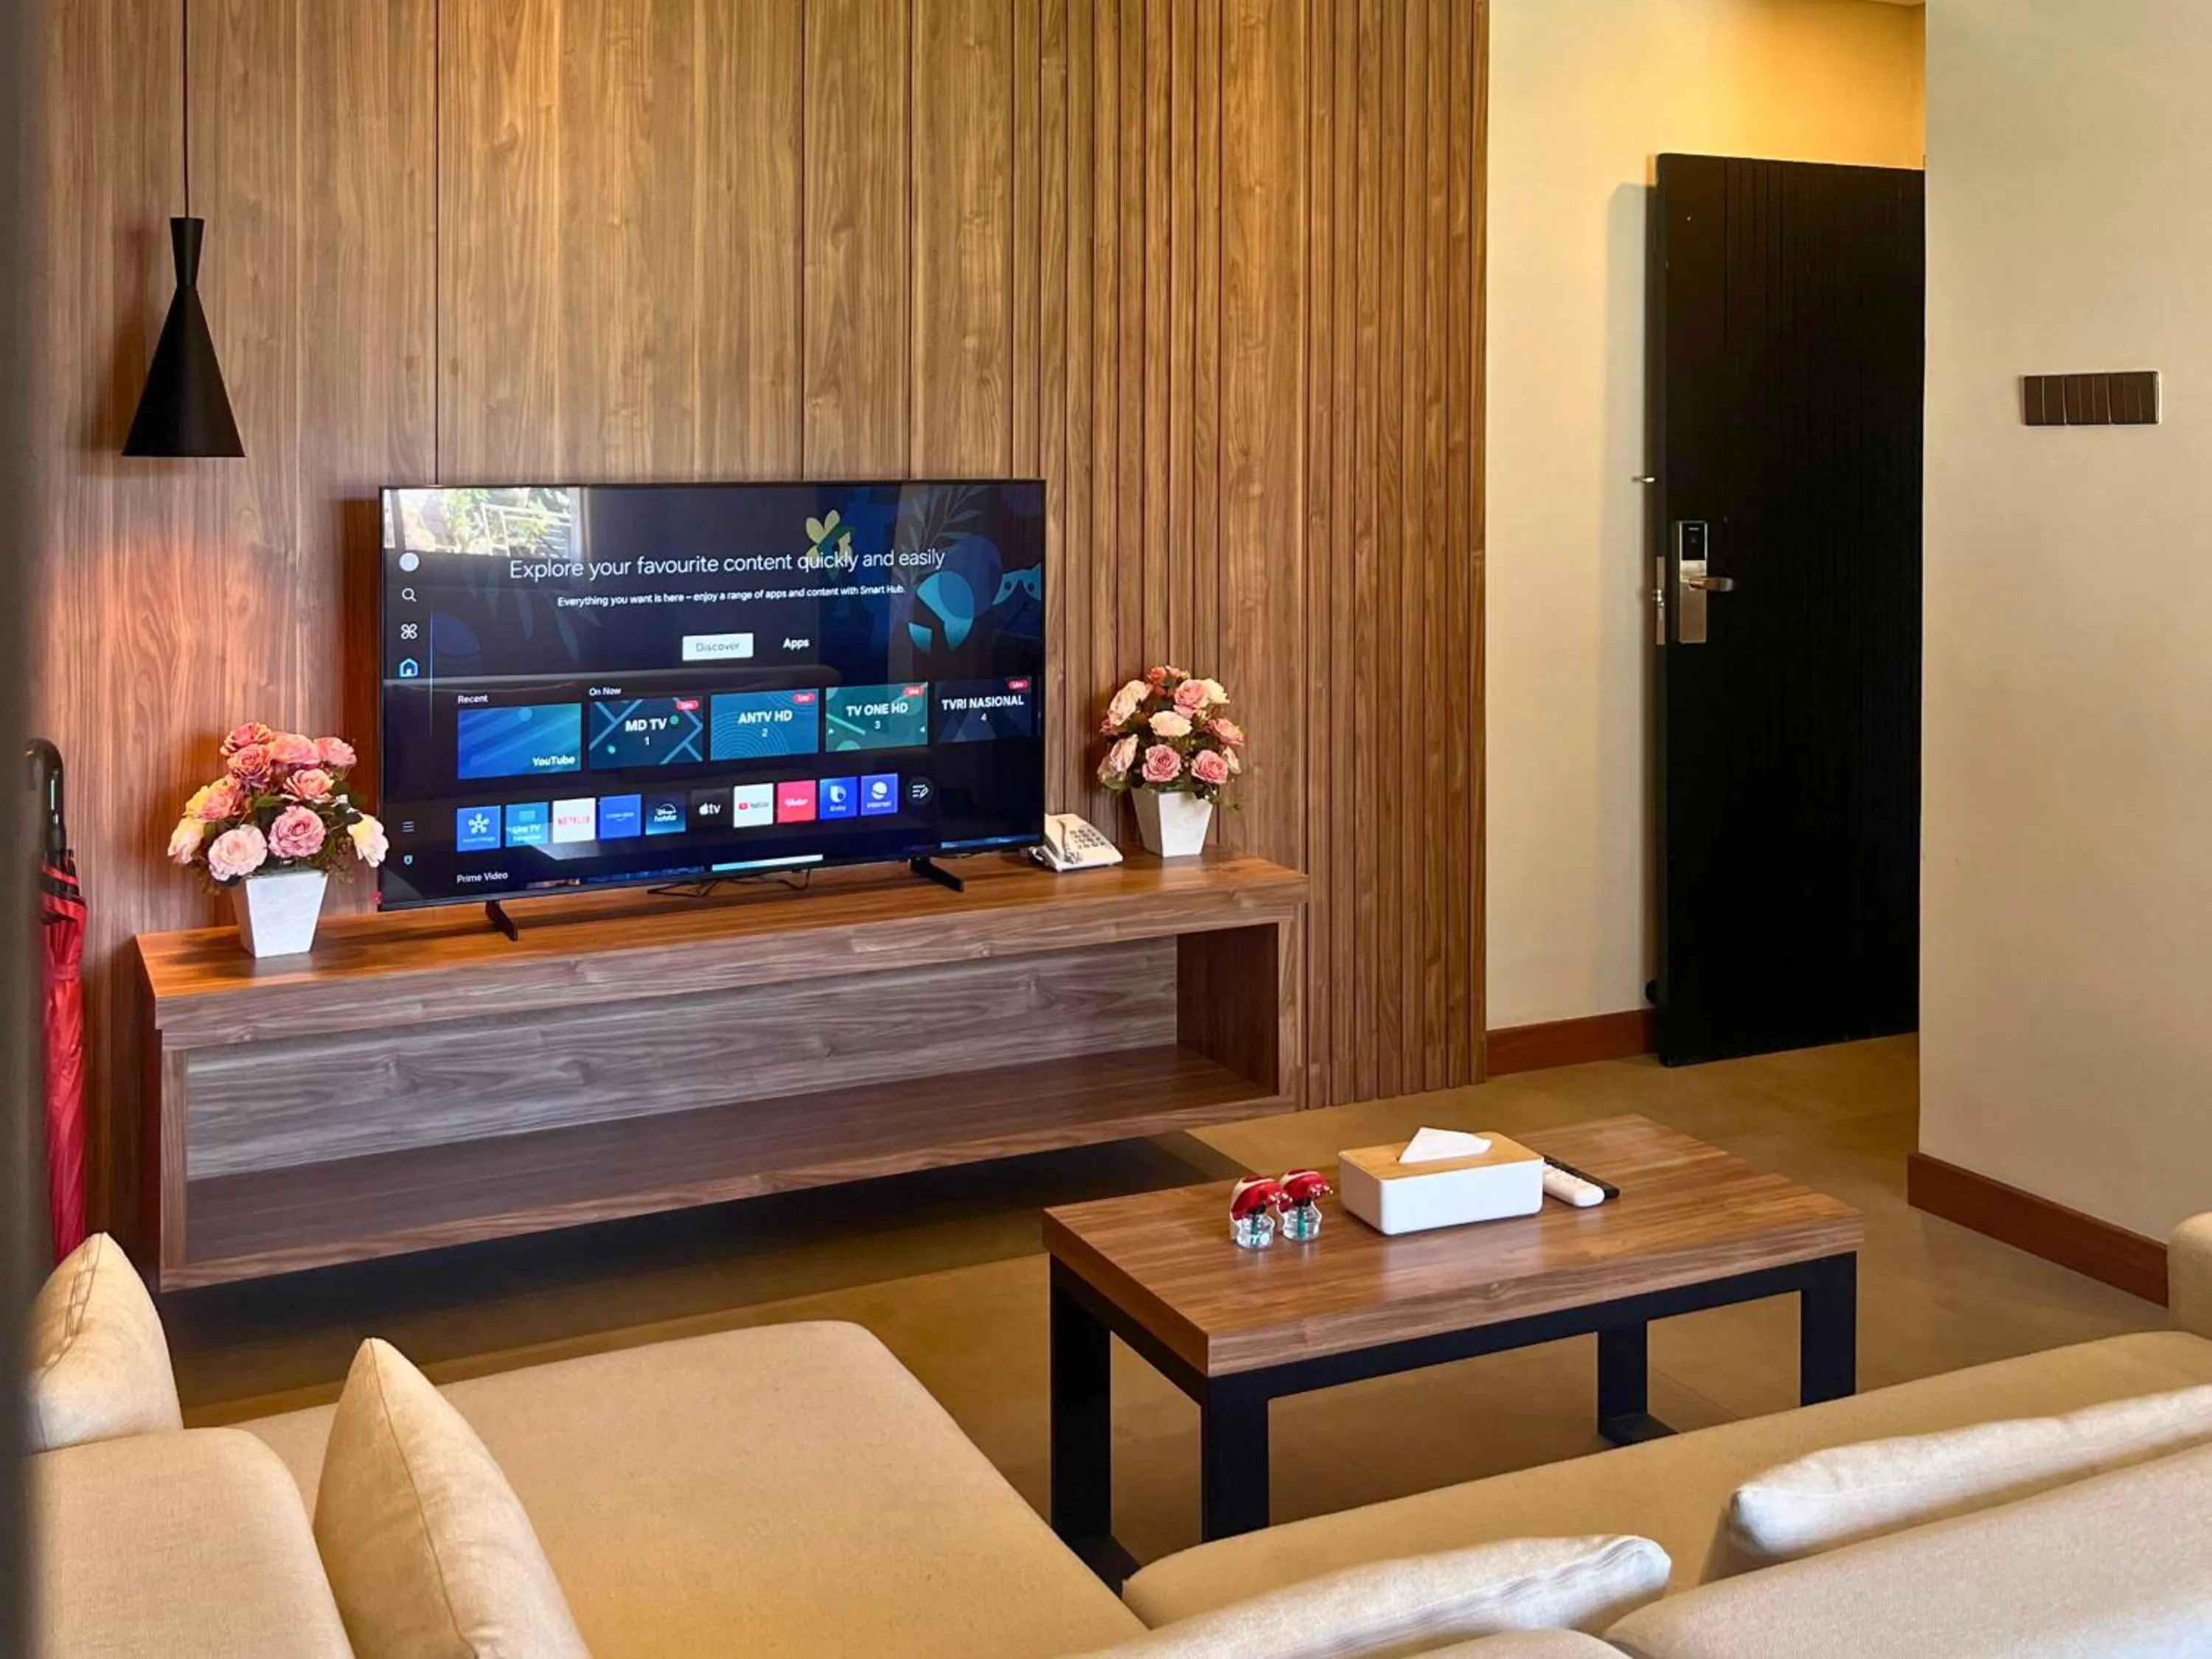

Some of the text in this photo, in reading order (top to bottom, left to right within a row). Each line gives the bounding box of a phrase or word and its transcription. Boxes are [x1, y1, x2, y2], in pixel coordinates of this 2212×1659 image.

[510, 549, 945, 582] Explore your favourite content quickly and easily
[557, 596, 608, 608] Everything
[611, 596, 627, 607] you
[630, 594, 653, 603] want
[654, 594, 662, 602] is
[664, 593, 684, 602] here
[693, 591, 718, 602] enjoy
[719, 592, 726, 600] a
[727, 591, 752, 601] range
[754, 590, 765, 599] of
[765, 591, 787, 601] apps
[788, 588, 804, 598] and
[807, 587, 838, 597] content
[841, 585, 858, 595] with
[860, 585, 885, 594] Smart
[695, 642, 740, 653] Discover
[782, 637, 810, 650] Apps
[589, 686, 622, 697] On Now
[458, 694, 488, 704] Recent
[942, 695, 1024, 711] TVRI NASIONAL
[846, 702, 908, 717] TV ONE HD
[738, 710, 793, 725] ANTV HD
[981, 713, 987, 721] 4
[625, 718, 667, 731] MD TV
[874, 720, 881, 729] 3
[762, 728, 768, 737] 2
[644, 736, 650, 745] 1
[532, 755, 576, 767] YouTube
[456, 872, 508, 884] Prime Video
